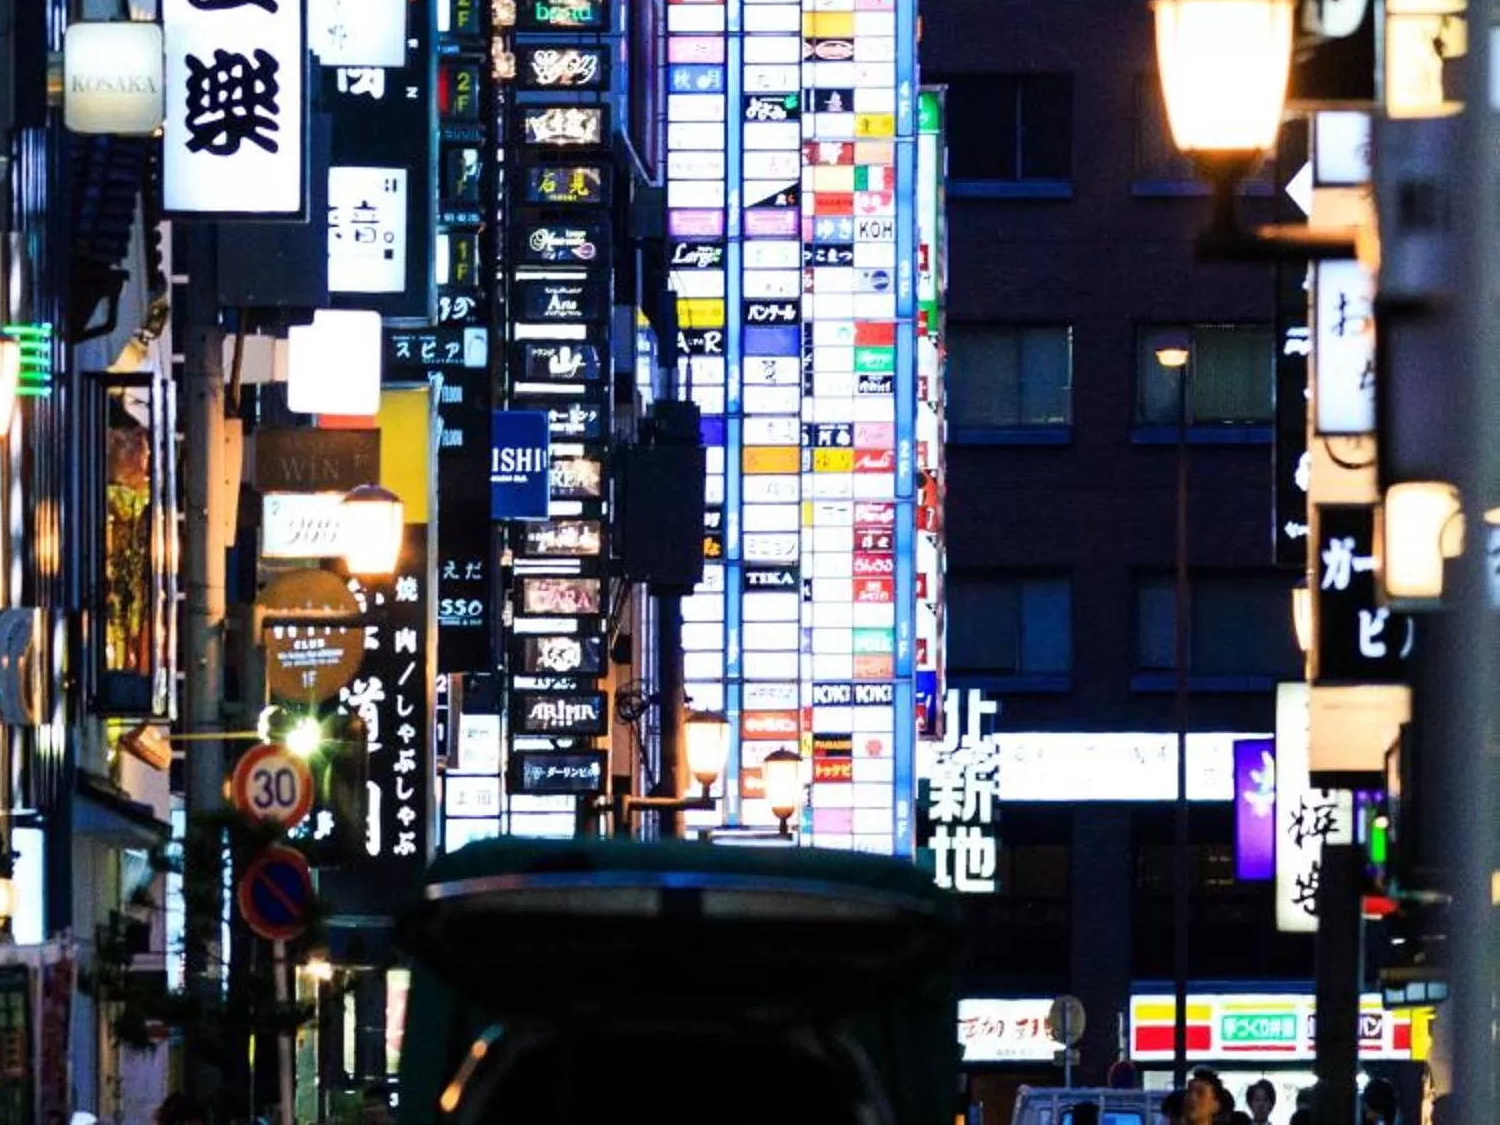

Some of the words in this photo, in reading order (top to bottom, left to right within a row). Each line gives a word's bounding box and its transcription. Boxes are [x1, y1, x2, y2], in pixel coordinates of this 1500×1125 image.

[253, 767, 296, 809] 30
[929, 687, 998, 894] 北新地
